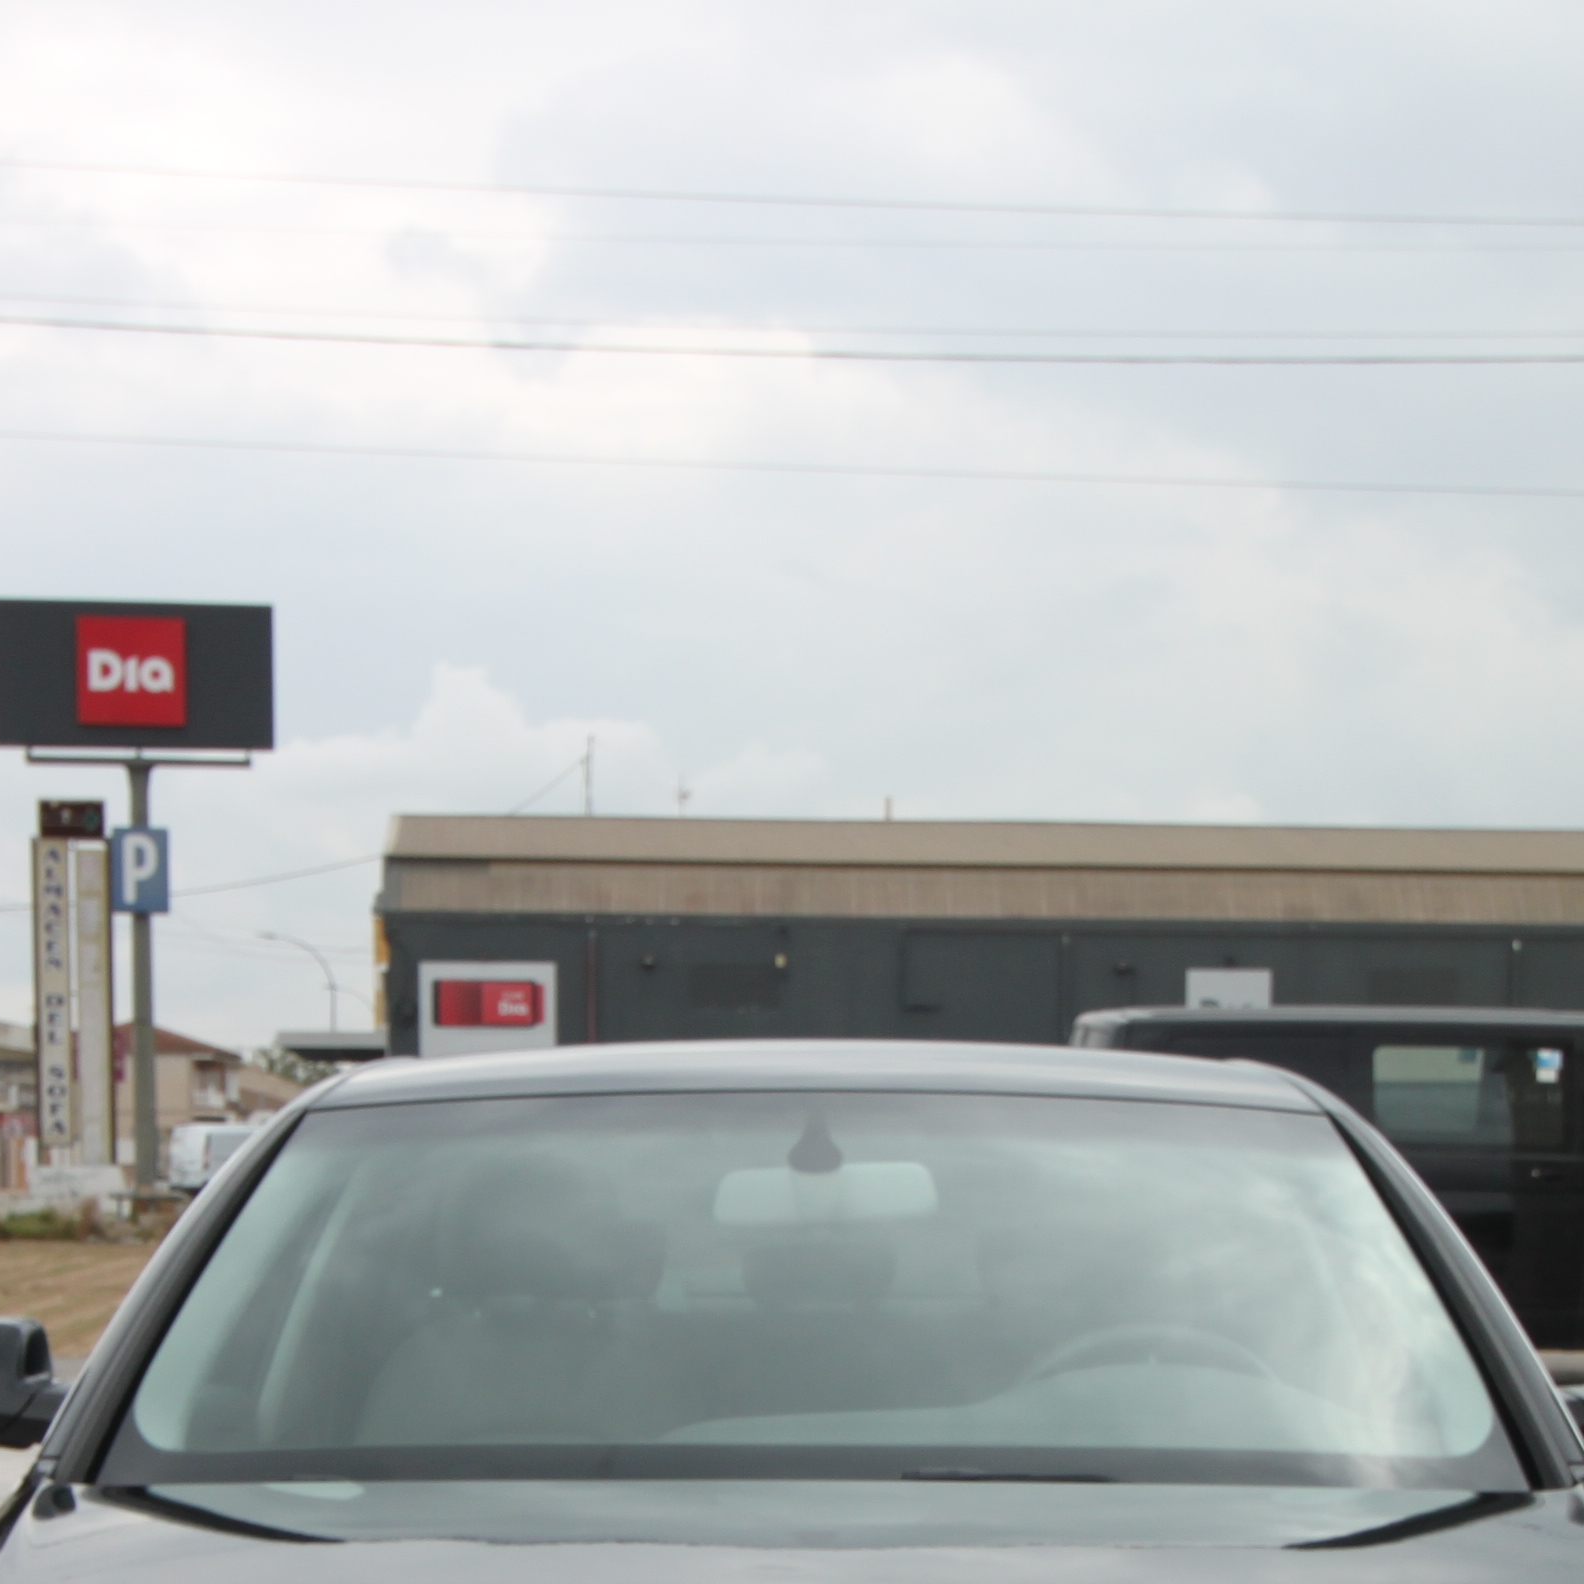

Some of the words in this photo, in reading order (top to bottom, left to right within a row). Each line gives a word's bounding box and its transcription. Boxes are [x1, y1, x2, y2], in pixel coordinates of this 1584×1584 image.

[121, 832, 160, 905] P
[45, 994, 64, 1045] DEL
[48, 1067, 67, 1134] SOFA
